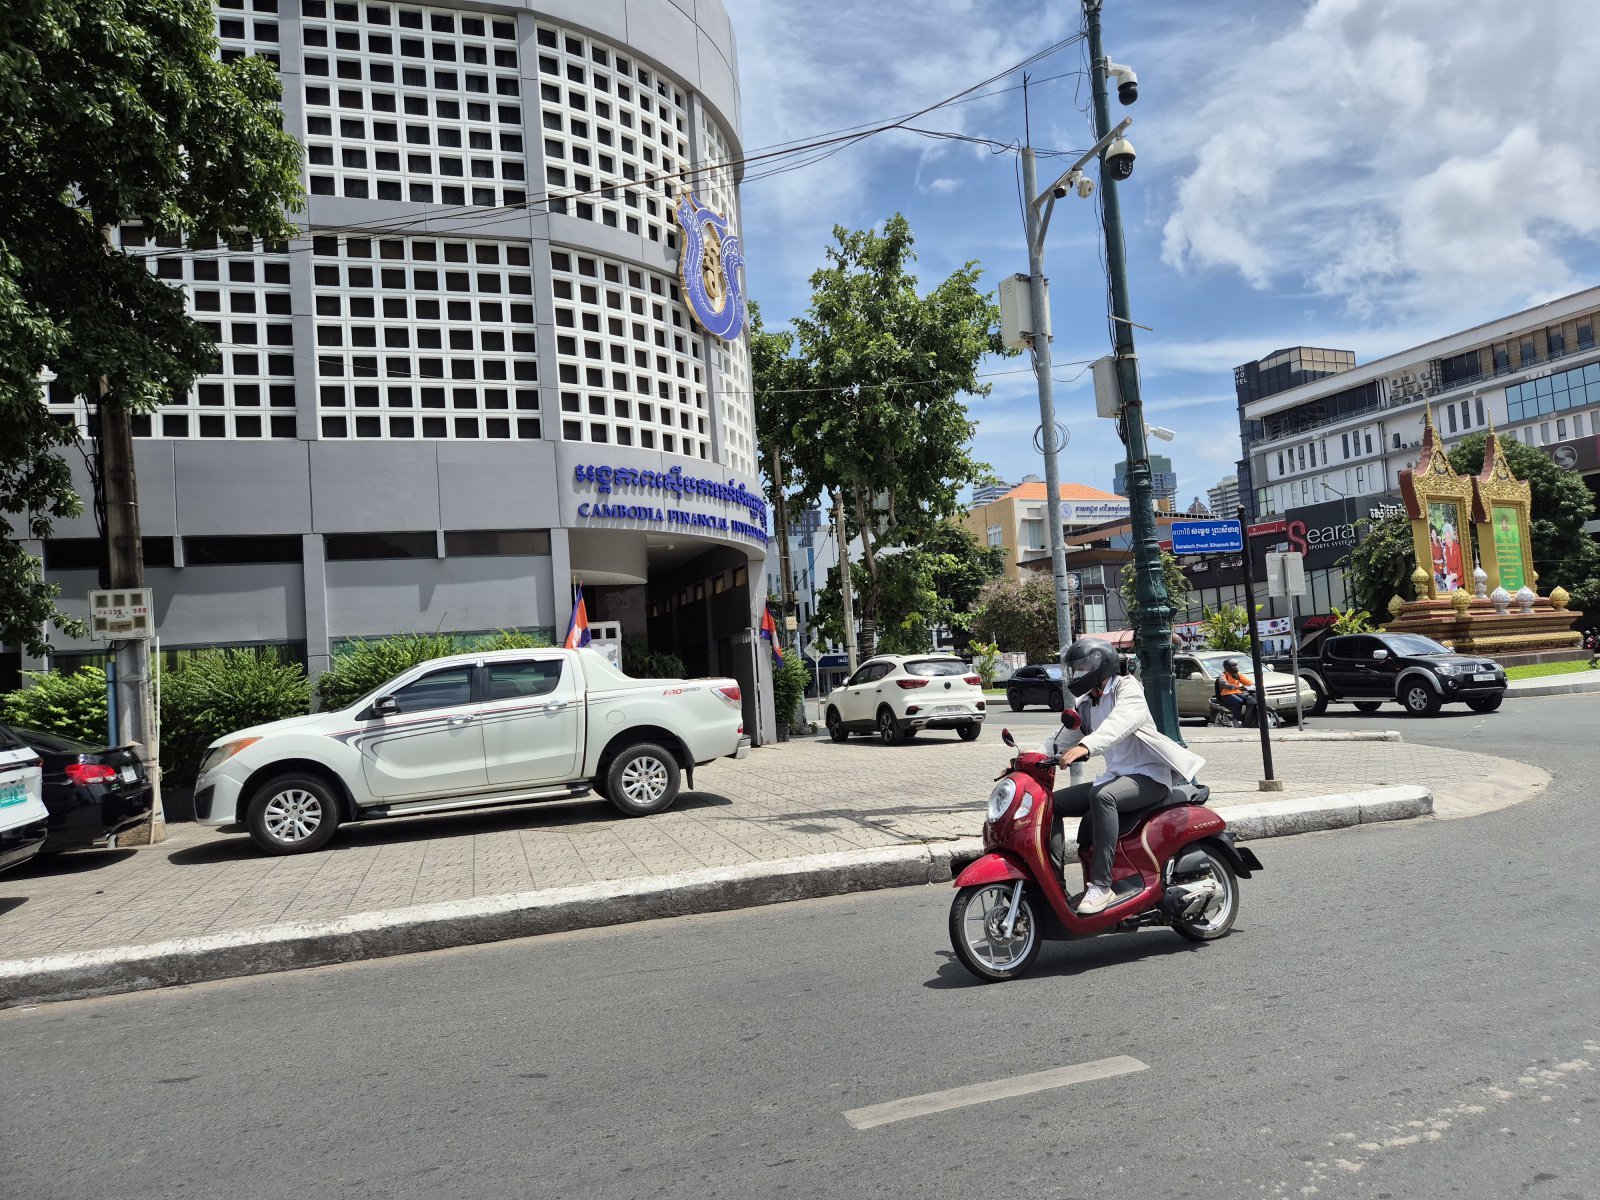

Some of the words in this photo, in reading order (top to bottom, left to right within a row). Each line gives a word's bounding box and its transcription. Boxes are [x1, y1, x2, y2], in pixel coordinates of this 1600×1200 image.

[578, 503, 664, 521] CAMBODIA
[668, 509, 729, 530] FINANCIAL
[1288, 520, 1356, 558] Seara
[1308, 542, 1330, 550] SPORTS
